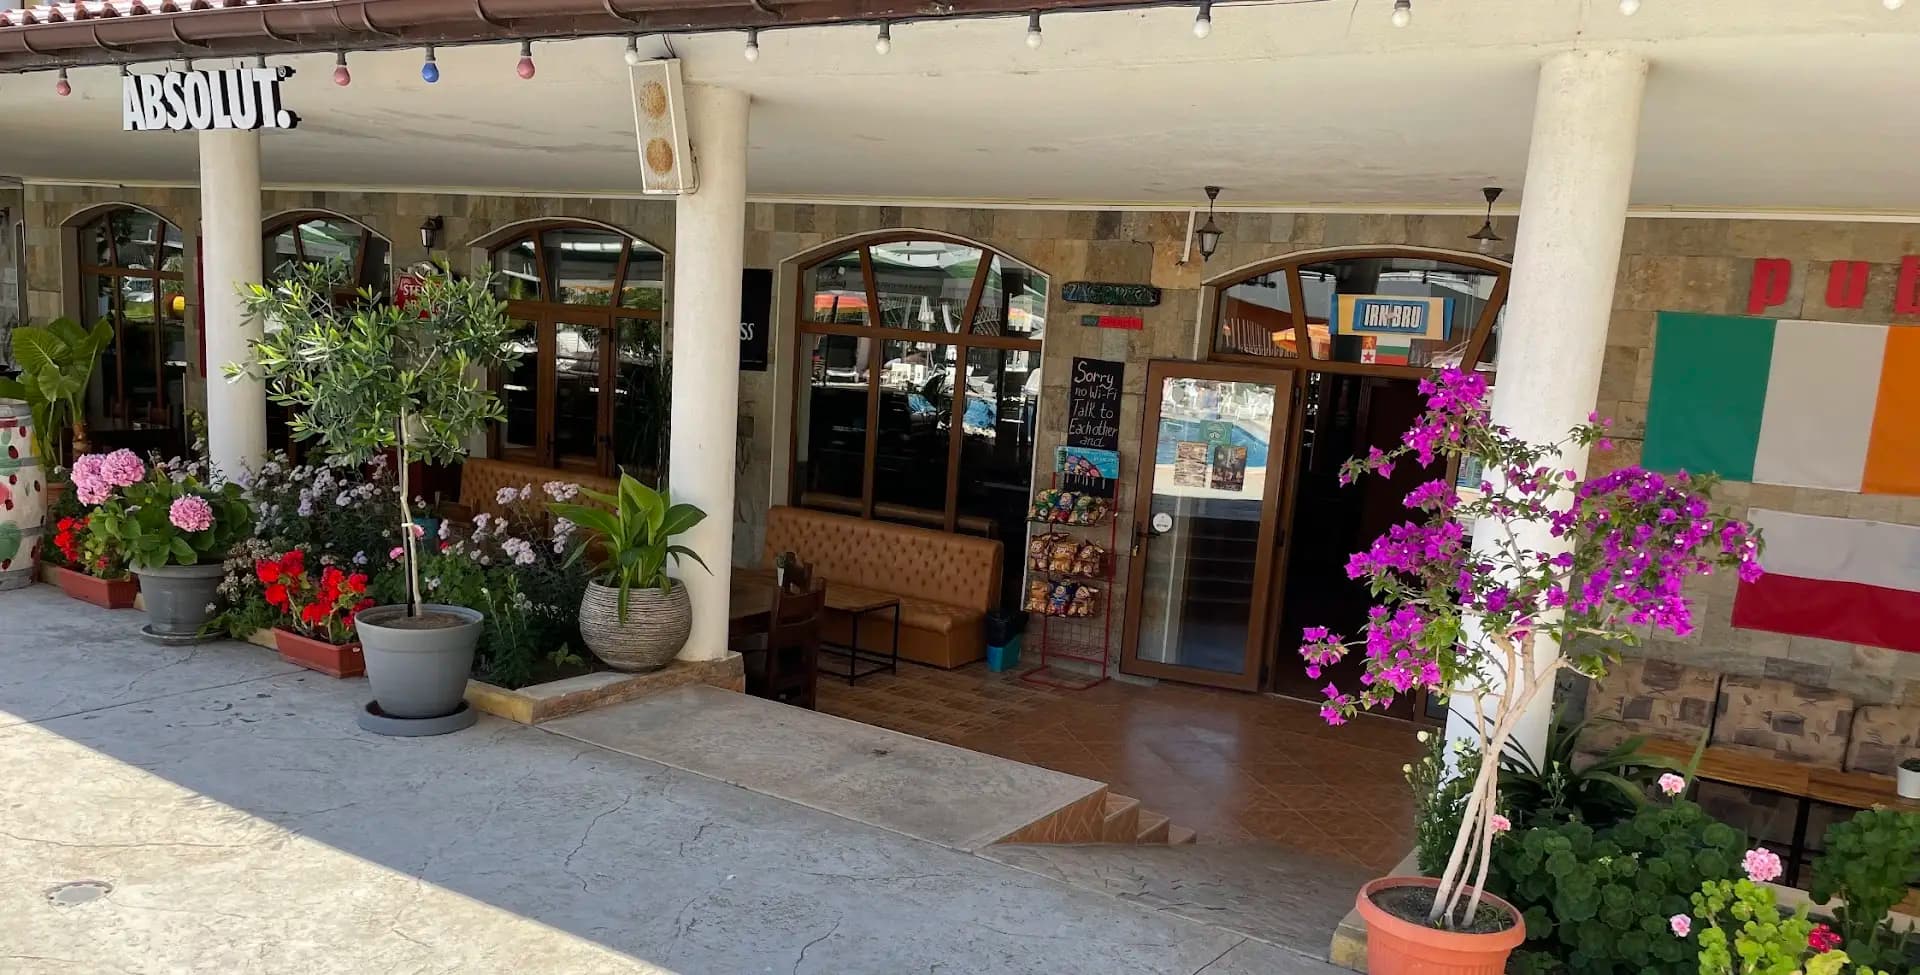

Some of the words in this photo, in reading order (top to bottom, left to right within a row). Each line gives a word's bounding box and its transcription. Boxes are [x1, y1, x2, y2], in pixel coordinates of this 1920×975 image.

[1074, 361, 1114, 389] Sorry
[1075, 387, 1087, 397] no
[1073, 398, 1096, 418] Talk
[1100, 403, 1114, 419] to
[1080, 437, 1105, 447] and
